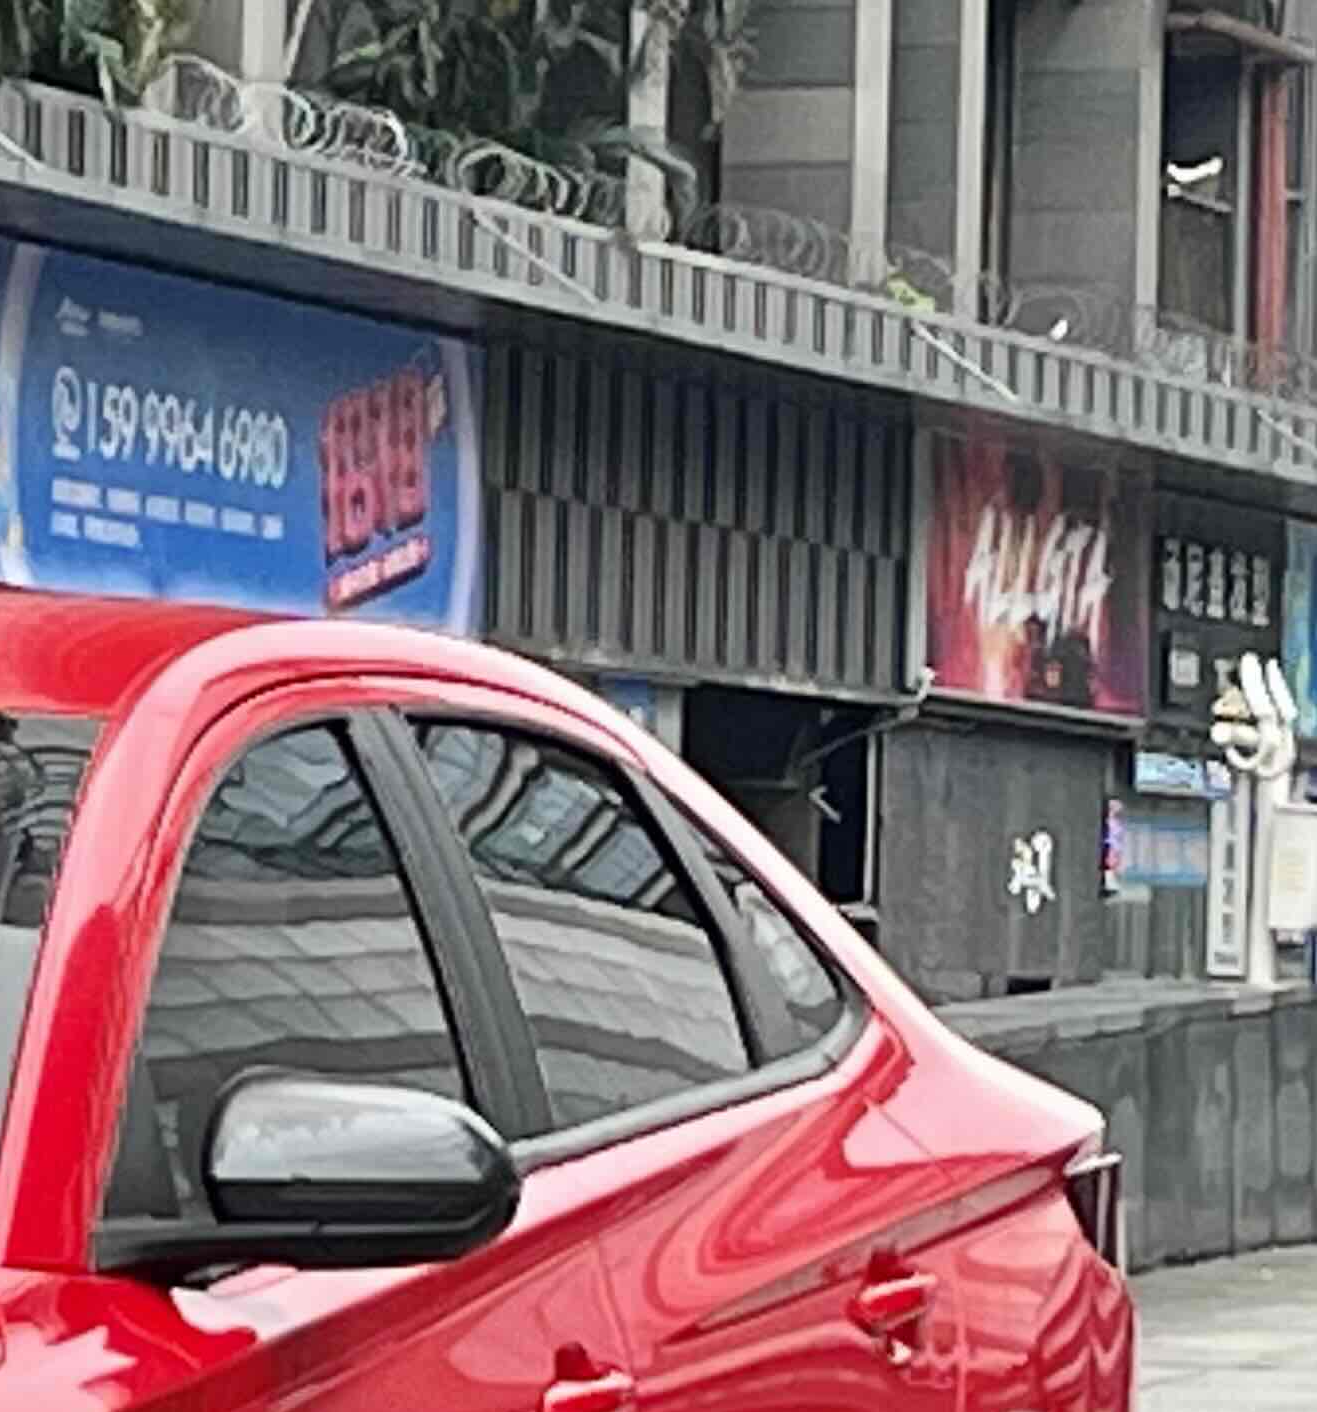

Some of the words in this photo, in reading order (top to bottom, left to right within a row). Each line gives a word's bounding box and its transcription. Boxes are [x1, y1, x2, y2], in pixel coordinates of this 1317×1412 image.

[86, 380, 140, 462] 159
[141, 387, 216, 474] 9964
[218, 402, 289, 489] 6980
